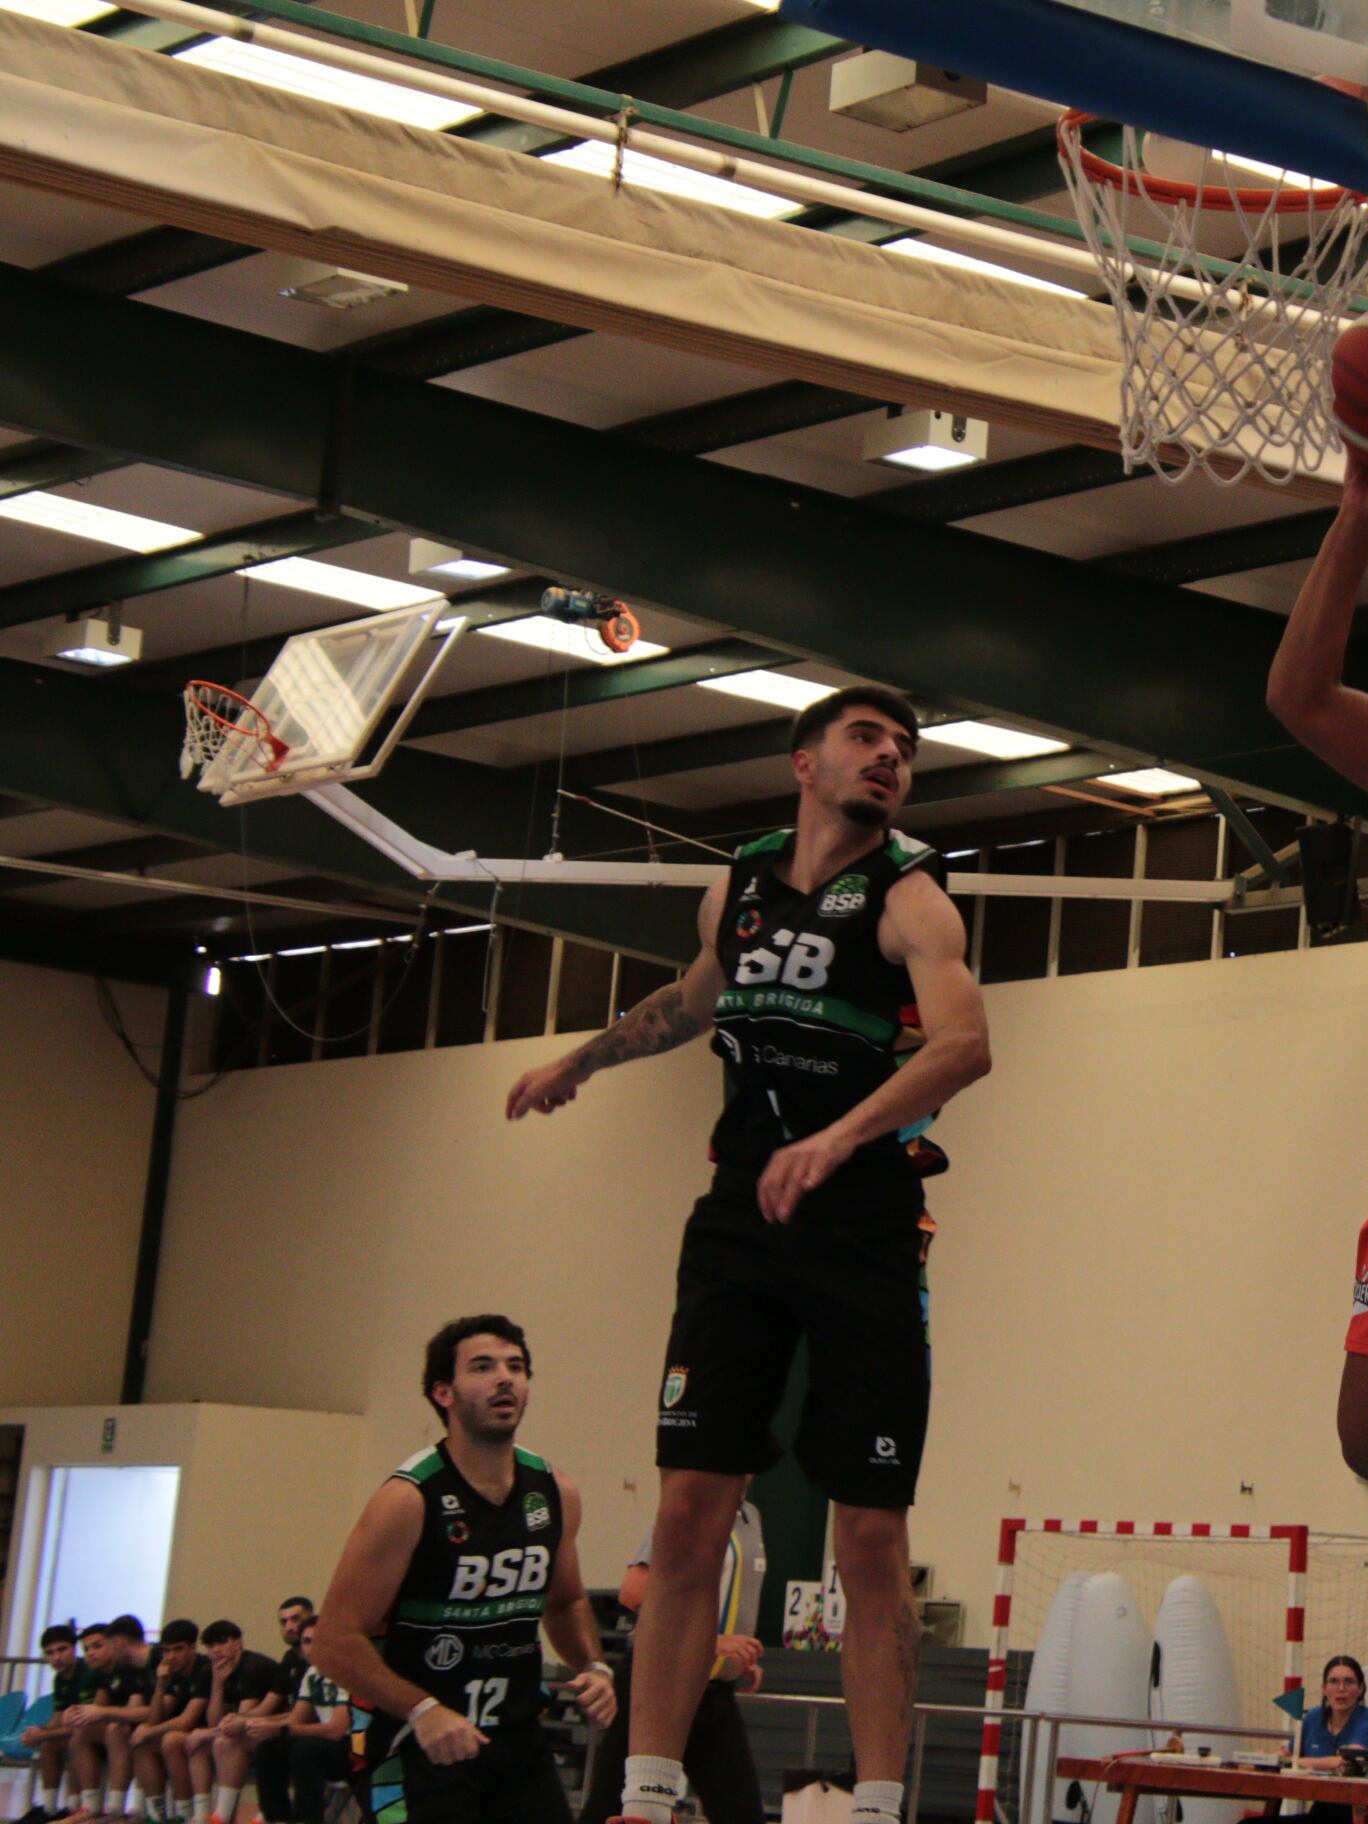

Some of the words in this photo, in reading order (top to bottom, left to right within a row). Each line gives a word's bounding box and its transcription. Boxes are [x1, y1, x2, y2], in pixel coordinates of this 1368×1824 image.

[821, 893, 866, 912] BSB
[449, 1545, 550, 1601] BSB
[789, 1587, 802, 1616] 2
[425, 1634, 464, 1671] MG
[463, 1678, 509, 1727] 12
